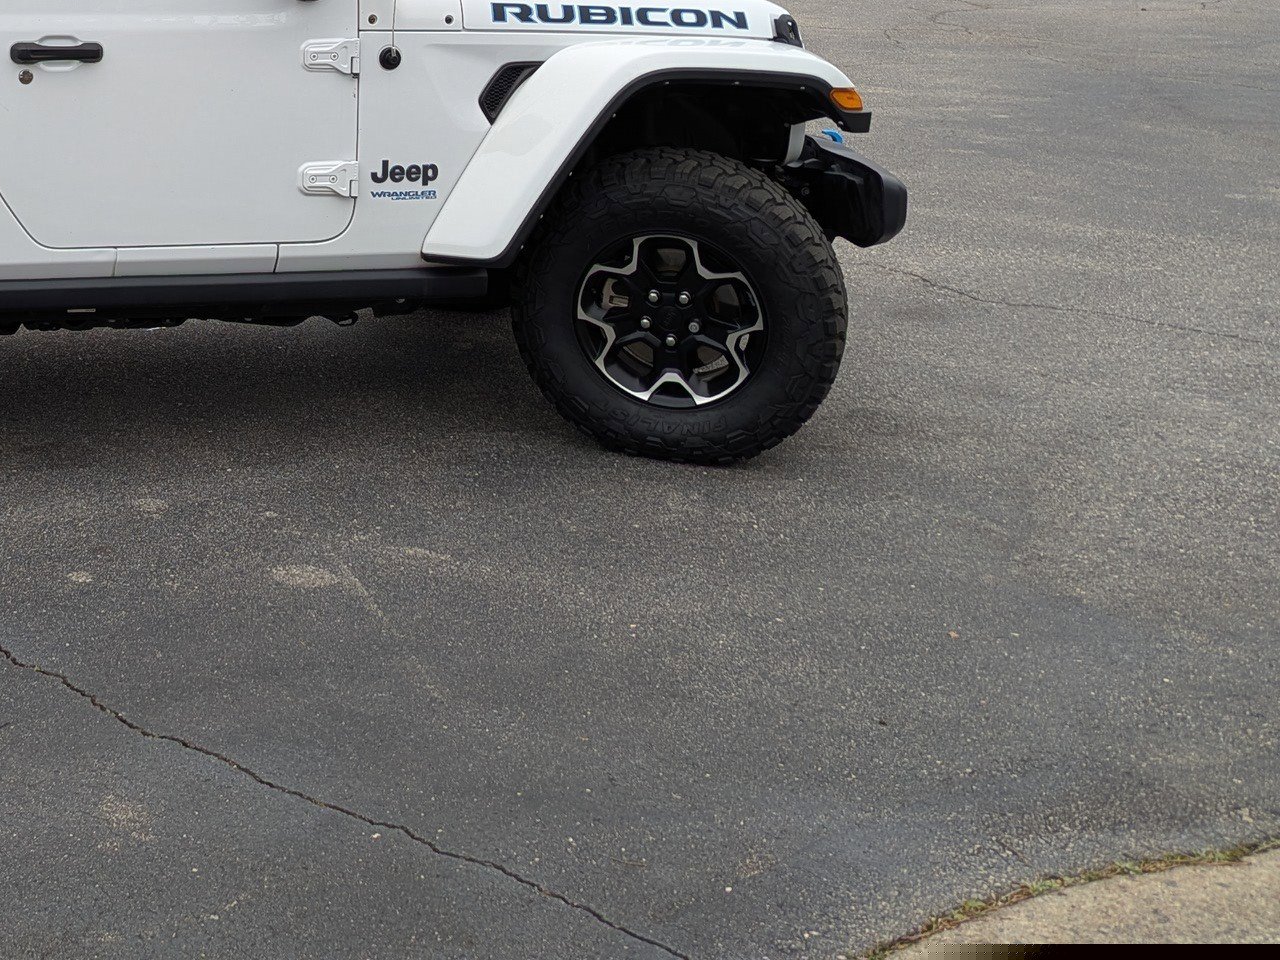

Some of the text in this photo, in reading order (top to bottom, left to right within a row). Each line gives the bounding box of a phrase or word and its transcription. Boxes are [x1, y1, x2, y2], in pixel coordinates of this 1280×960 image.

[490, 2, 749, 30] RUBICON
[370, 159, 439, 186] Jeep
[370, 190, 437, 198] WRANGLER
